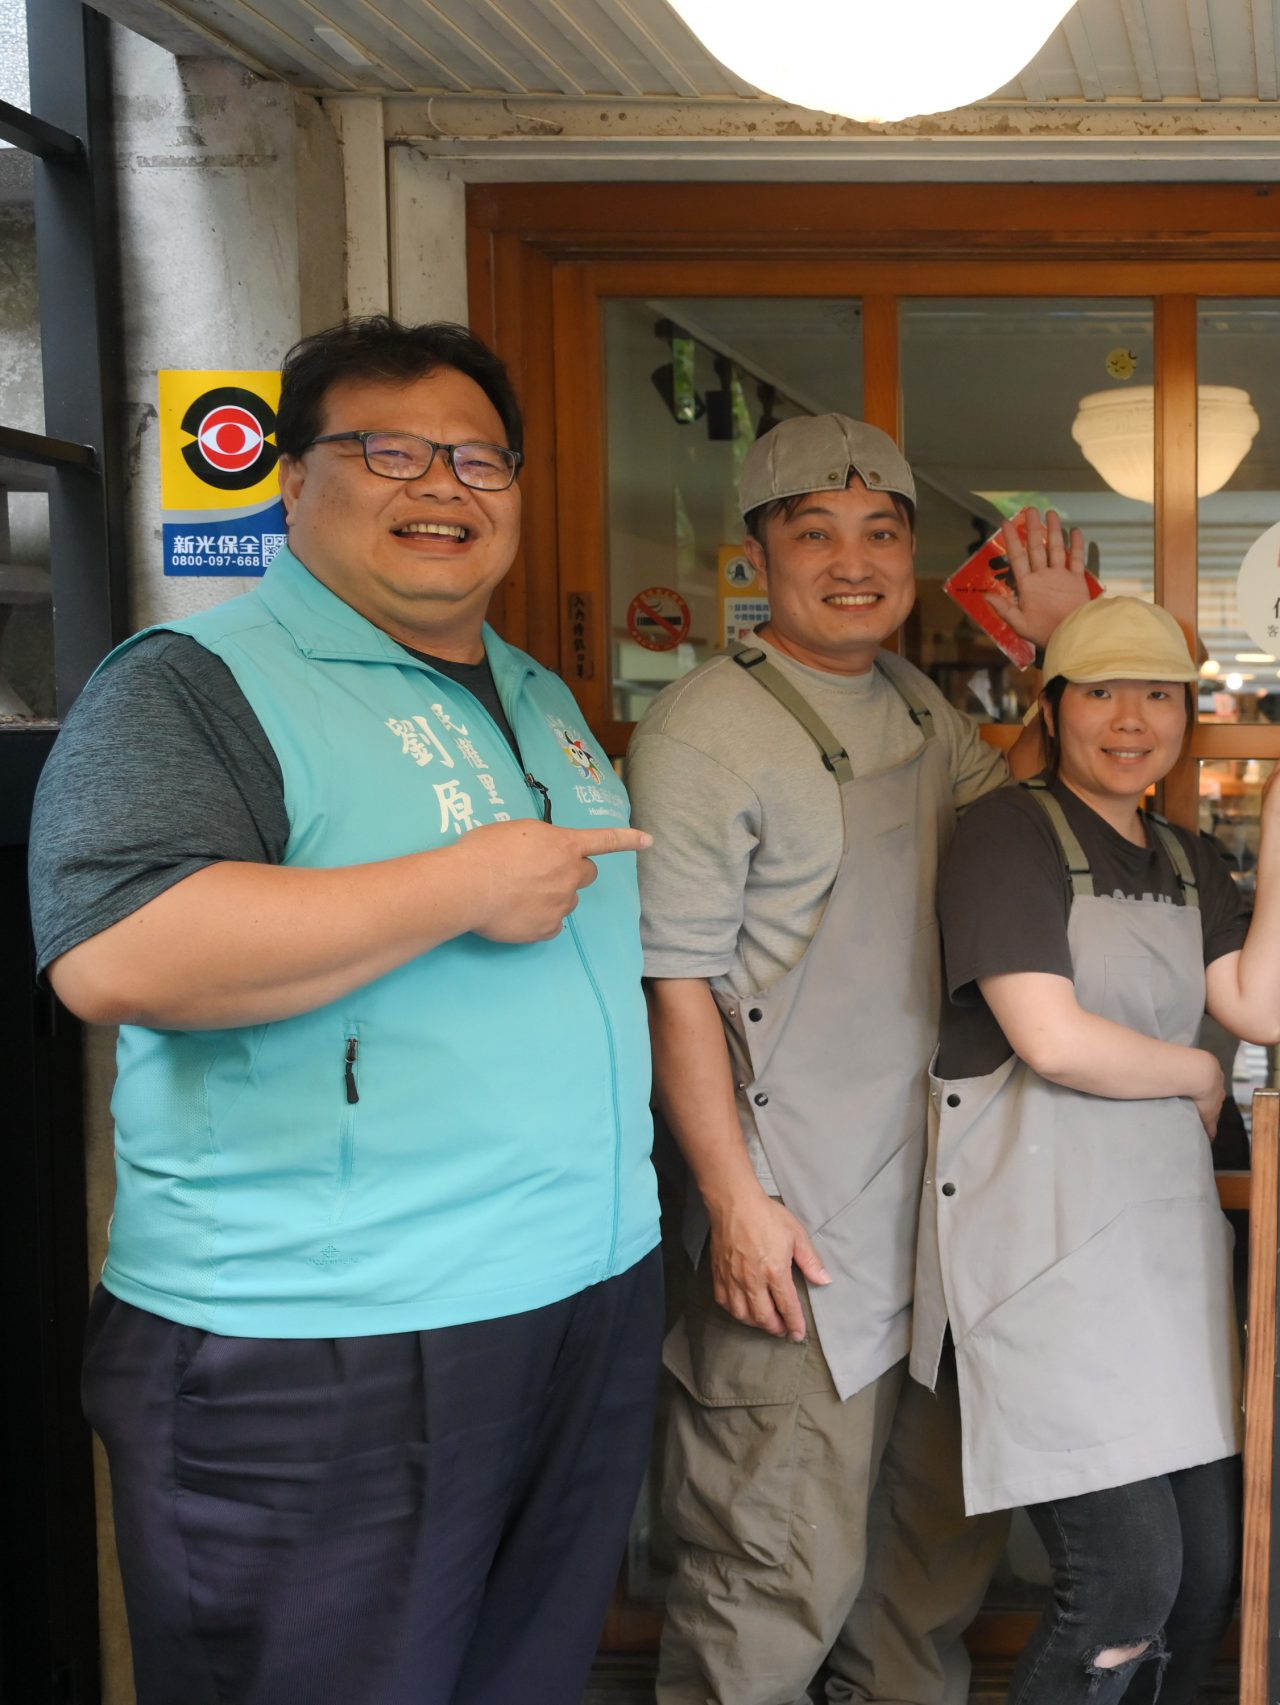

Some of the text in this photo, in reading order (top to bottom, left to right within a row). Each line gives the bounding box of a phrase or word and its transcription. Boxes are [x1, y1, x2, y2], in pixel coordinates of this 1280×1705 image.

[173, 535, 260, 554] 新光保全
[172, 555, 260, 566] 0800-097-668
